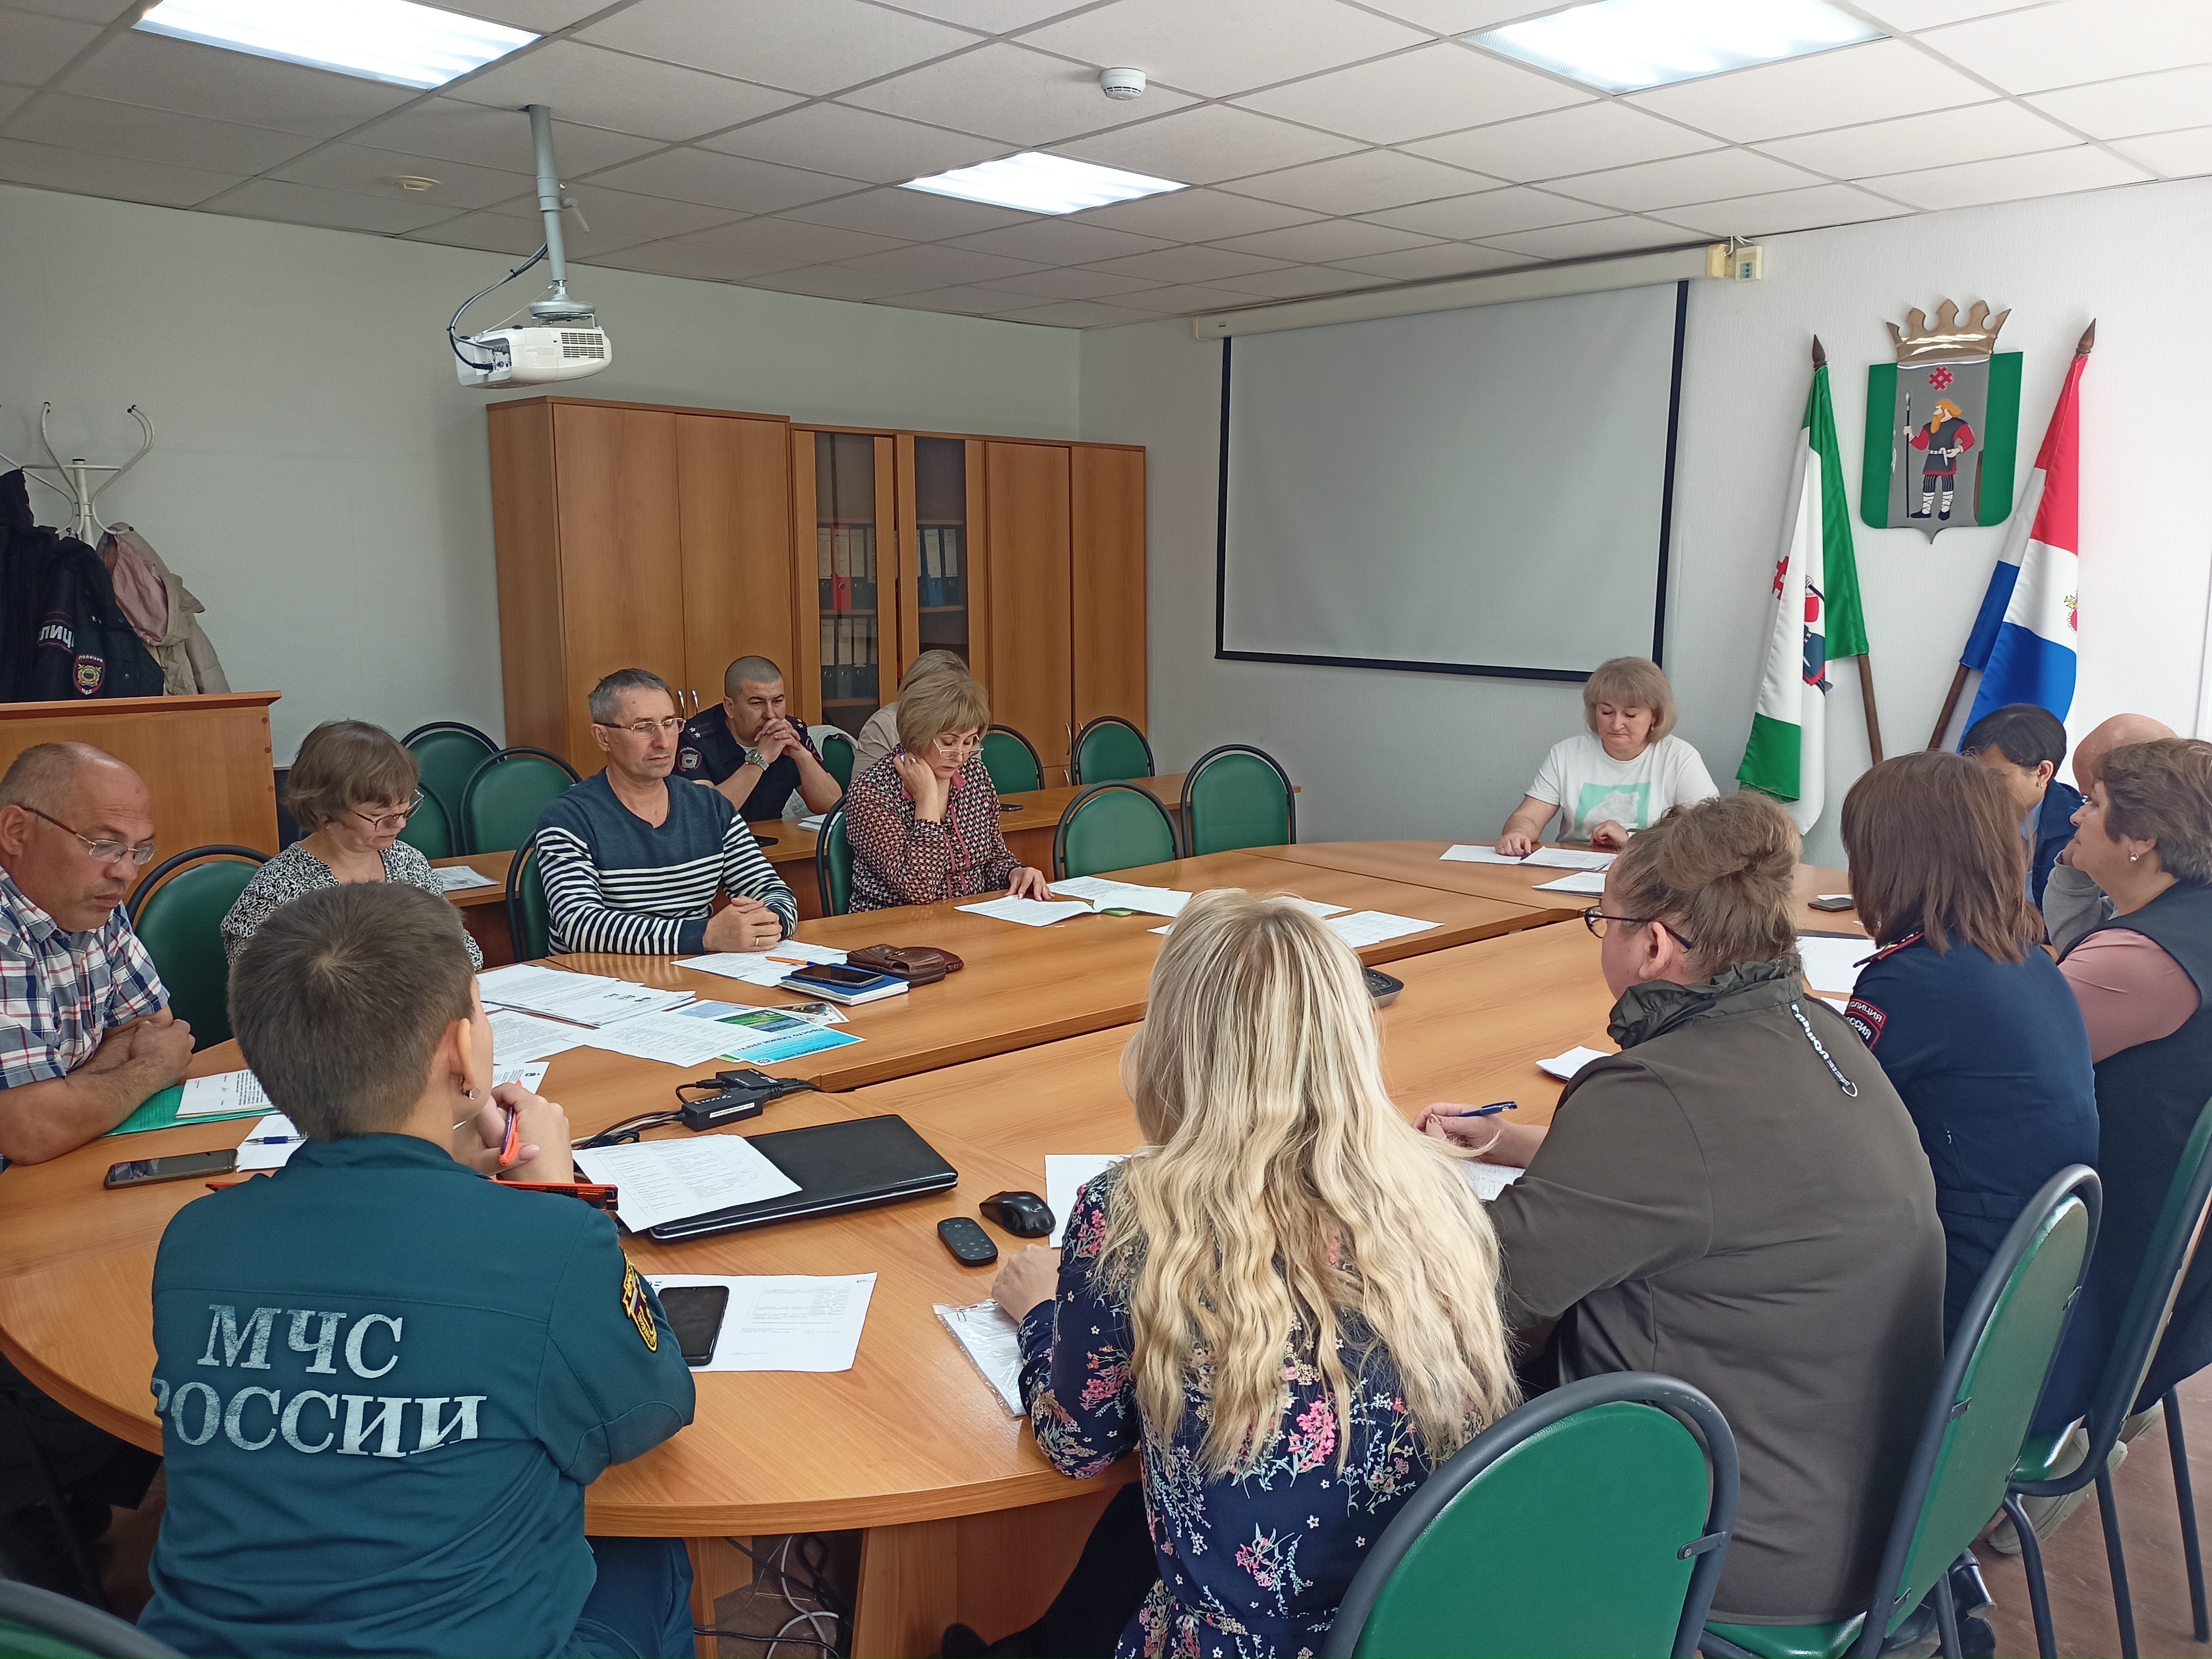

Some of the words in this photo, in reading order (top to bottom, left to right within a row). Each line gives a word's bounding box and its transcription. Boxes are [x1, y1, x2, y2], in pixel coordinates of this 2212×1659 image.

[38, 624, 74, 648] ЛИЦ
[1846, 1016, 1872, 1040] ССИЯ
[197, 1304, 403, 1379] МЧС
